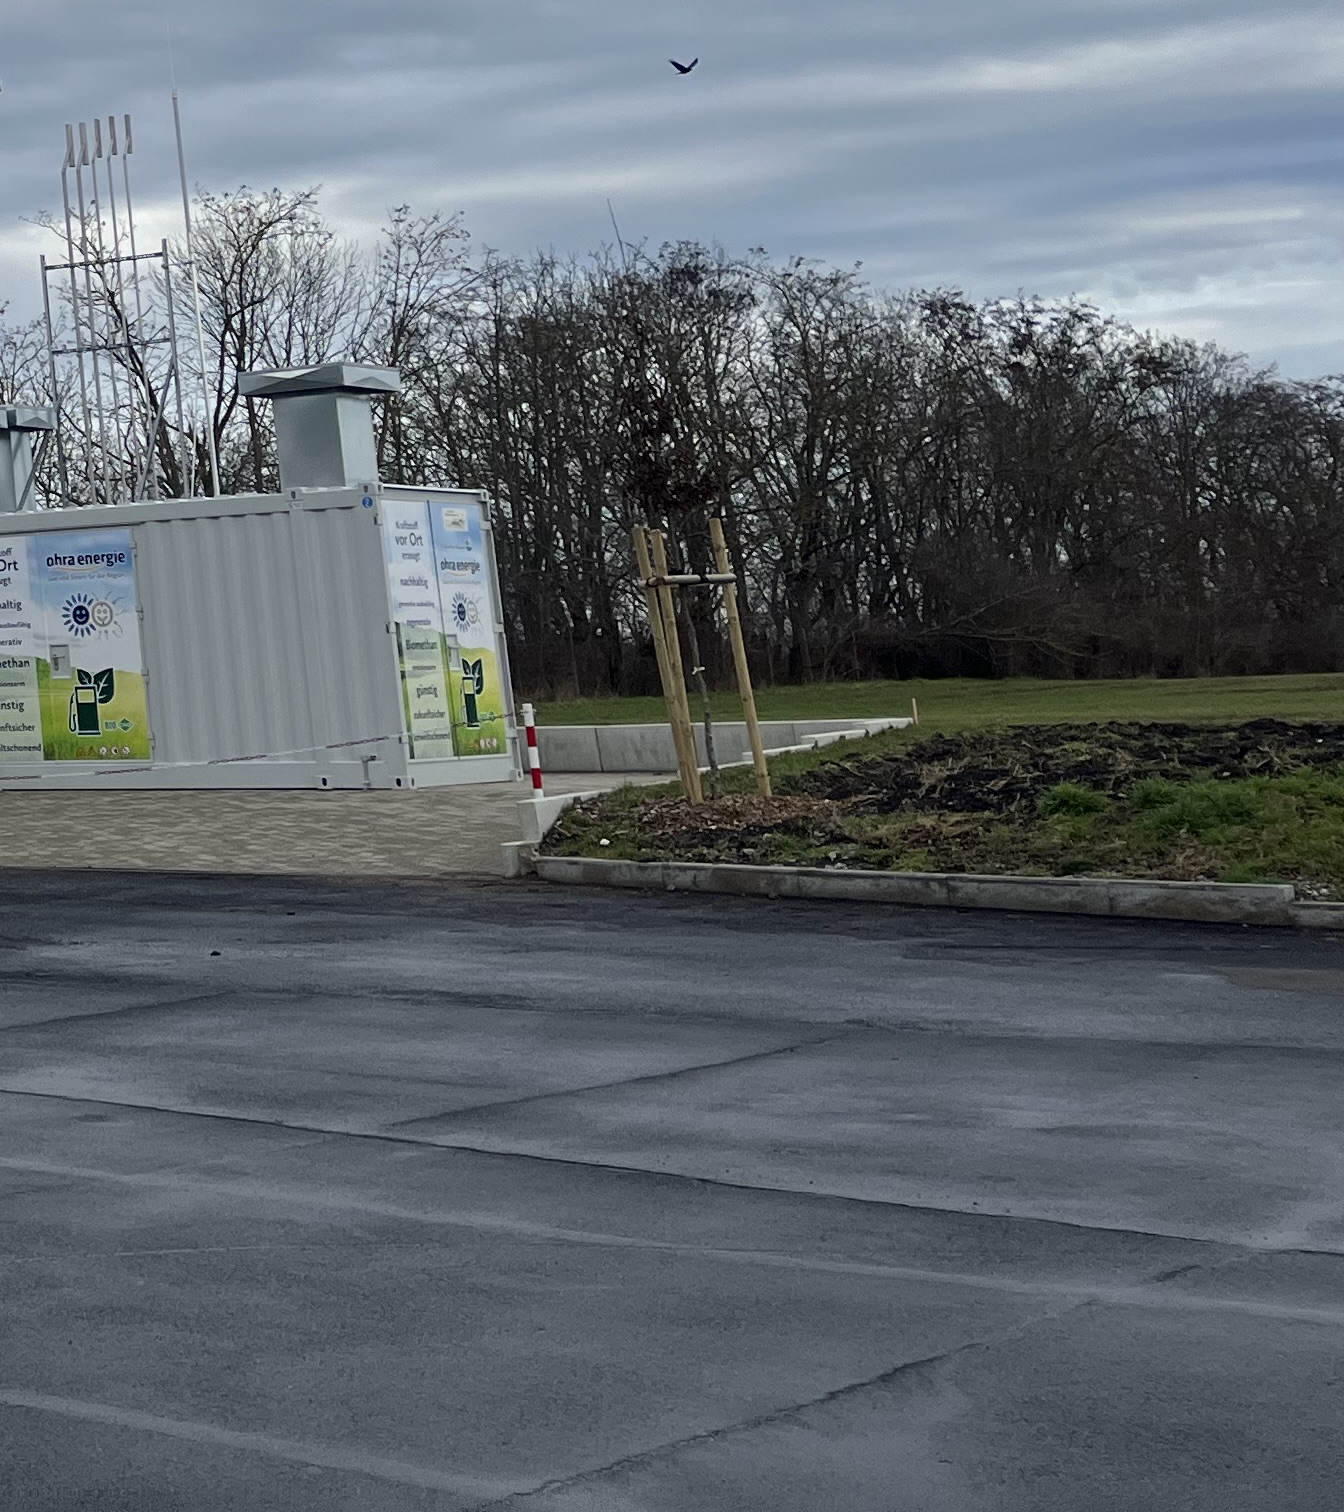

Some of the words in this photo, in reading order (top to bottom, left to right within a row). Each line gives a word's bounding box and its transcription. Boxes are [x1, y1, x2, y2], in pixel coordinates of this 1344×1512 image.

[395, 536, 407, 546] vor
[409, 533, 423, 546] Ort
[46, 553, 75, 567] ohra
[77, 549, 126, 567] energie
